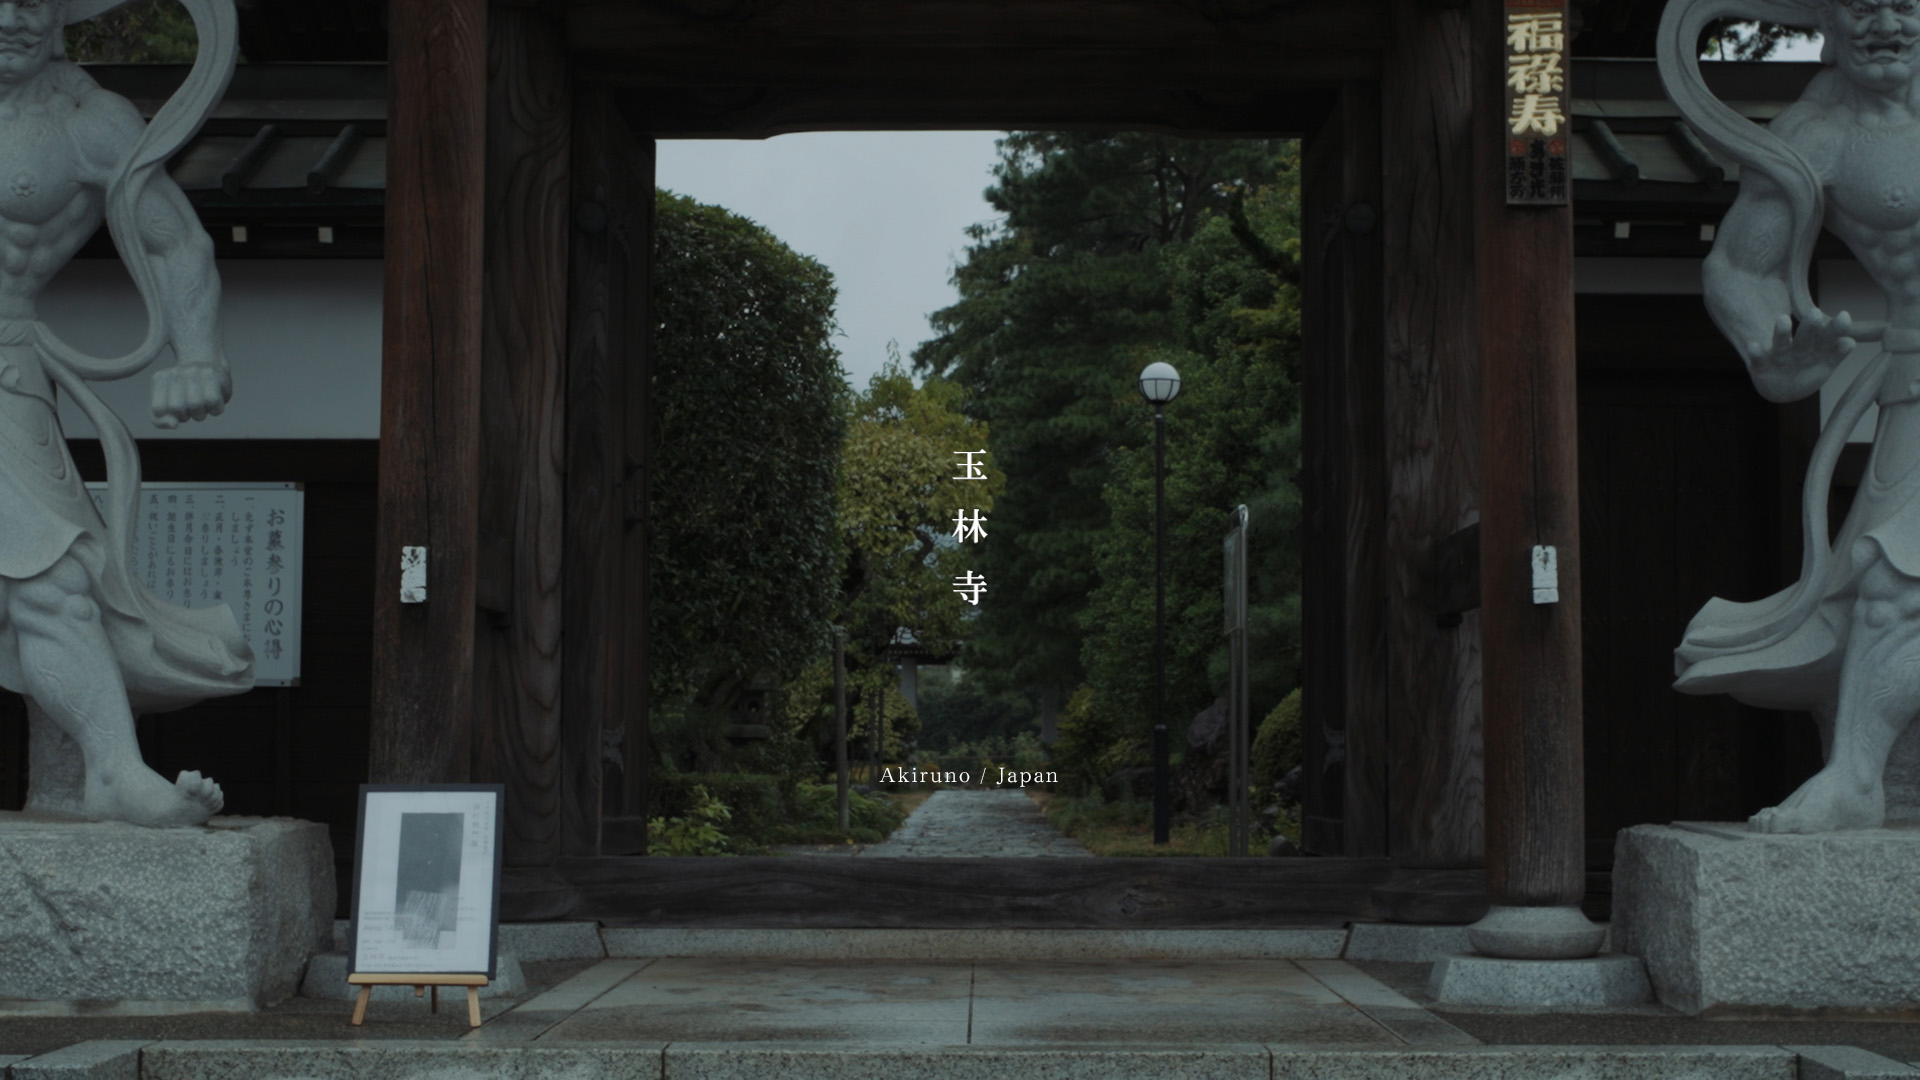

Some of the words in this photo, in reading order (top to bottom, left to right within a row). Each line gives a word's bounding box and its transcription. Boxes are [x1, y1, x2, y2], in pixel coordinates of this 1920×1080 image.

[1507, 12, 1565, 136] 福禄寿
[264, 508, 285, 660] お墓参りの心得
